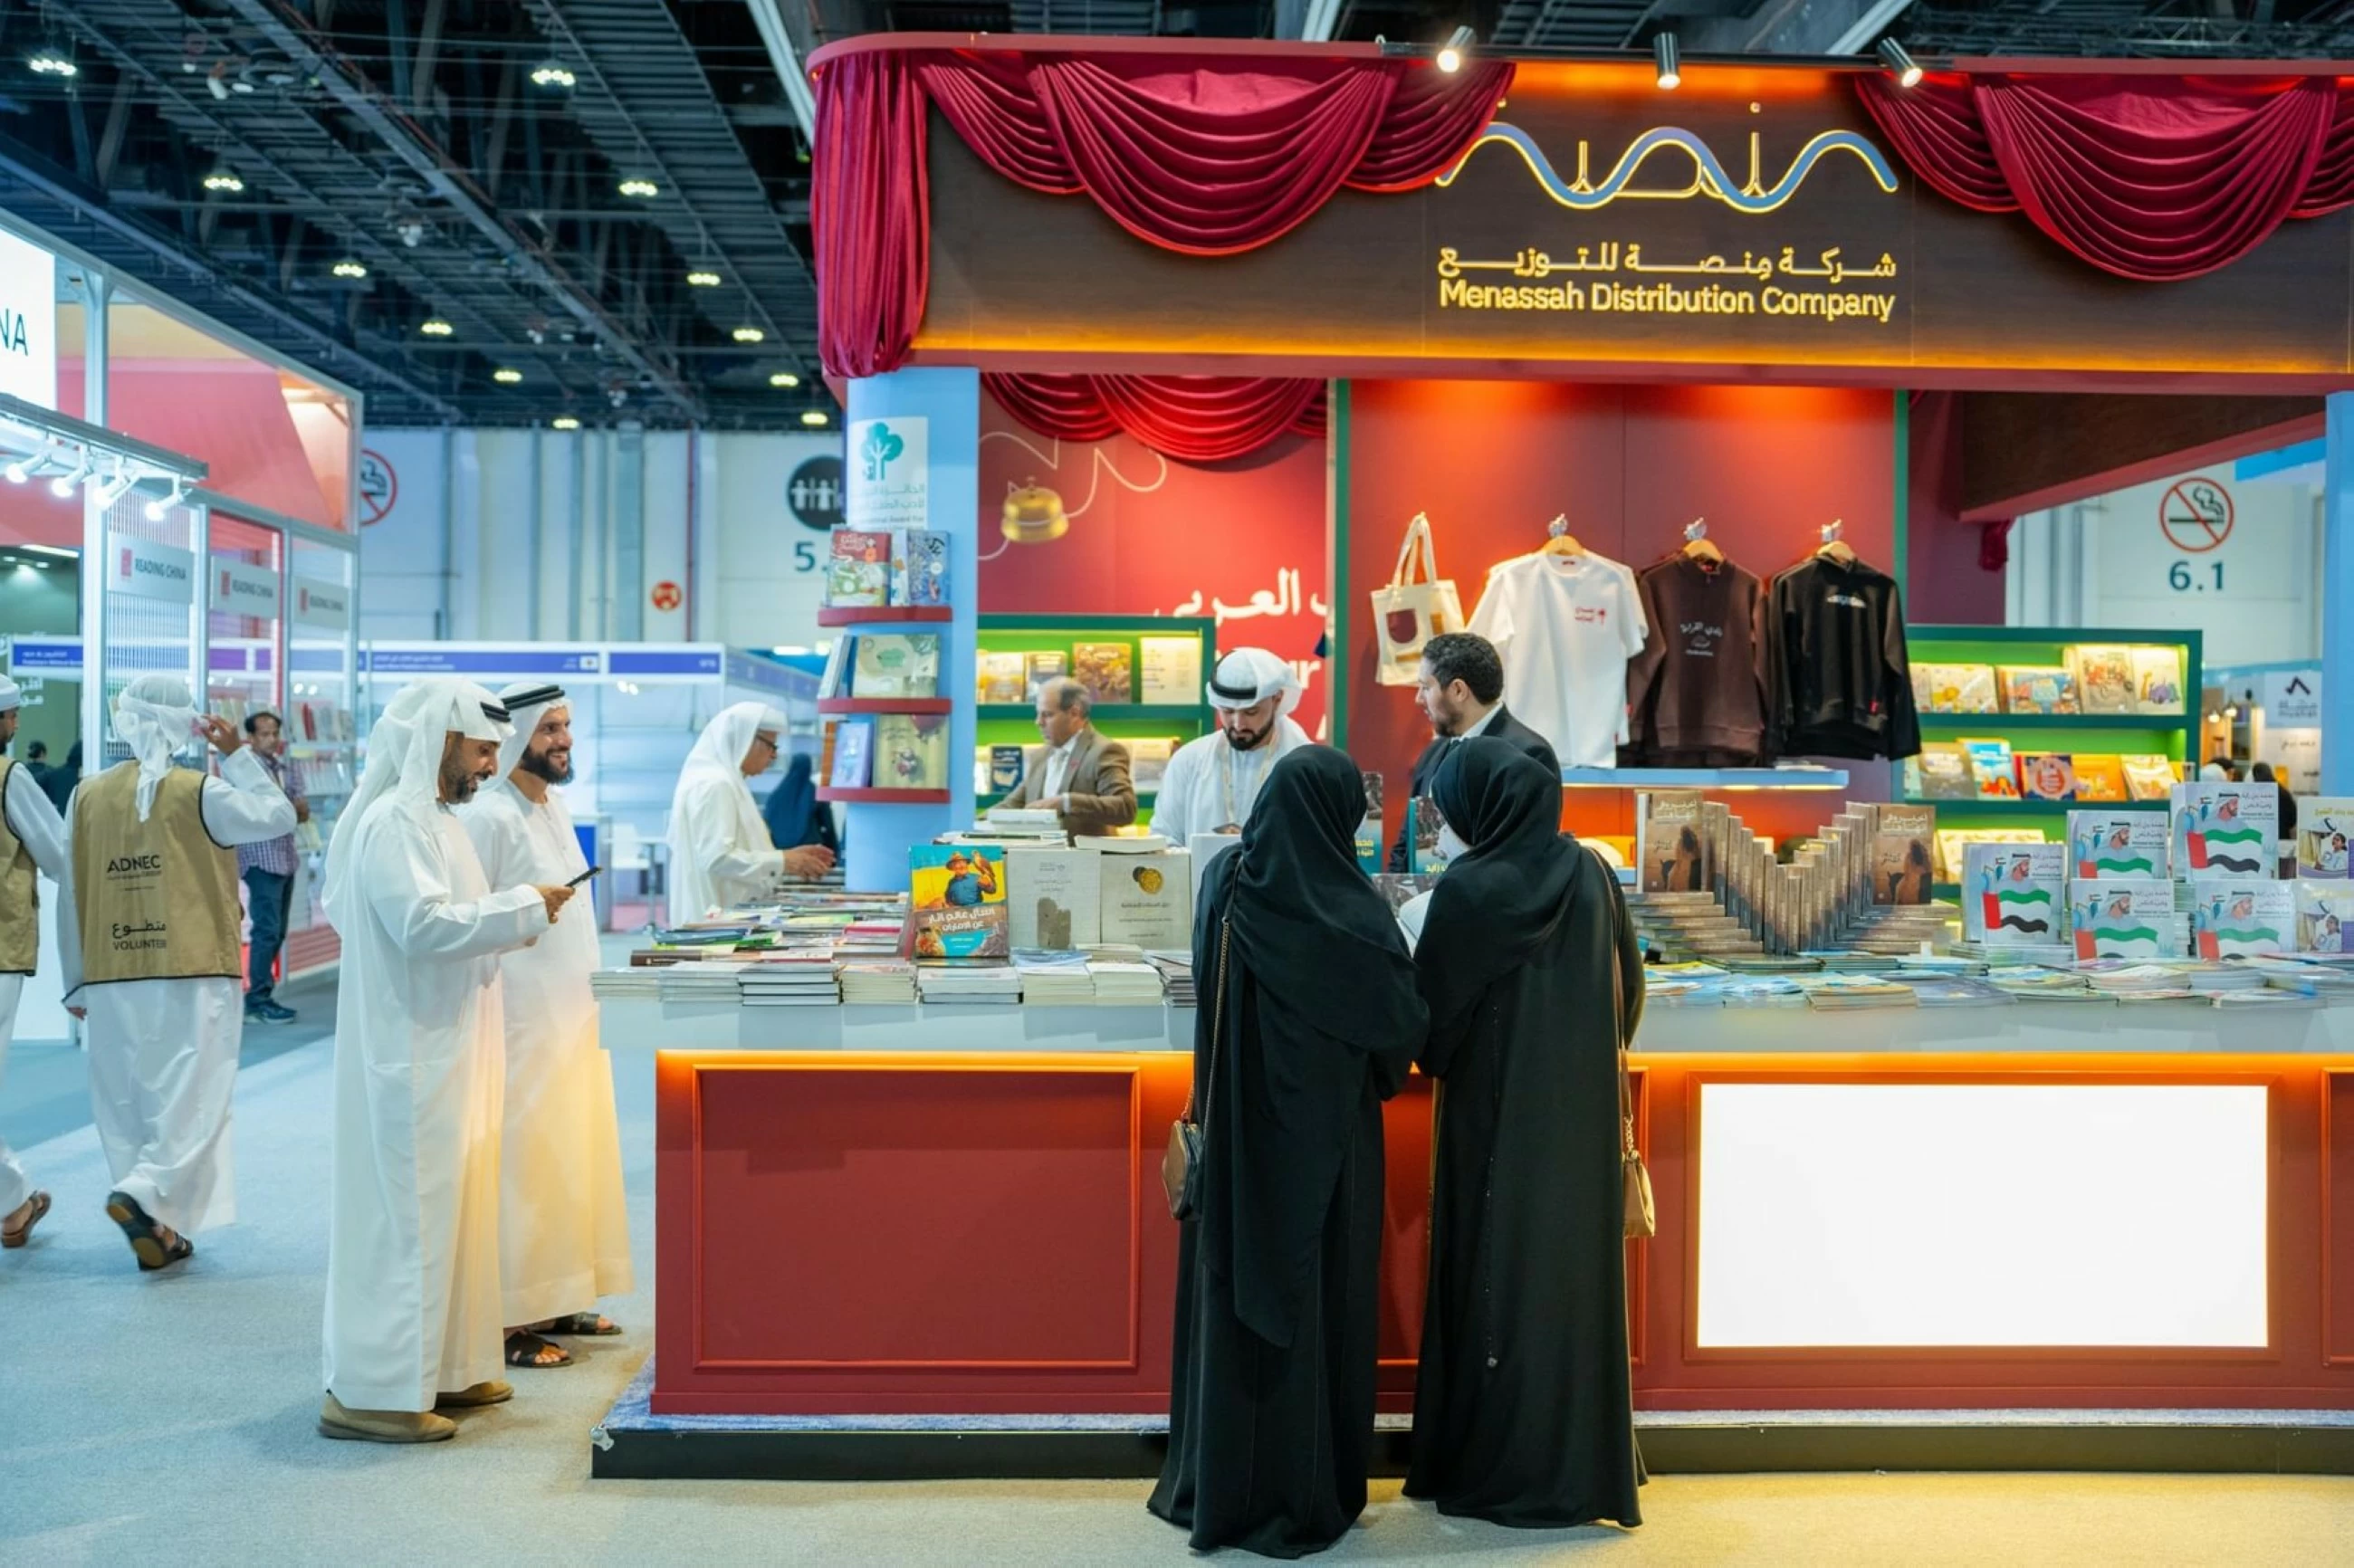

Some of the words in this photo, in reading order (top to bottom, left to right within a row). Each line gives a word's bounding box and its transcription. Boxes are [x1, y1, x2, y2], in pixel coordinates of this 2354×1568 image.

[1438, 242, 1619, 277] للتوزيع
[1778, 247, 1897, 283] شركة
[1440, 279, 1584, 310] Menassah
[1591, 282, 1755, 313] Distribution
[1762, 285, 1896, 322] Company
[135, 558, 165, 578] READING
[166, 564, 187, 580] CHINA
[795, 540, 828, 572] 5.
[2168, 560, 2225, 591] 6.1
[107, 855, 161, 873] ADNEC
[112, 919, 167, 939] متطوع
